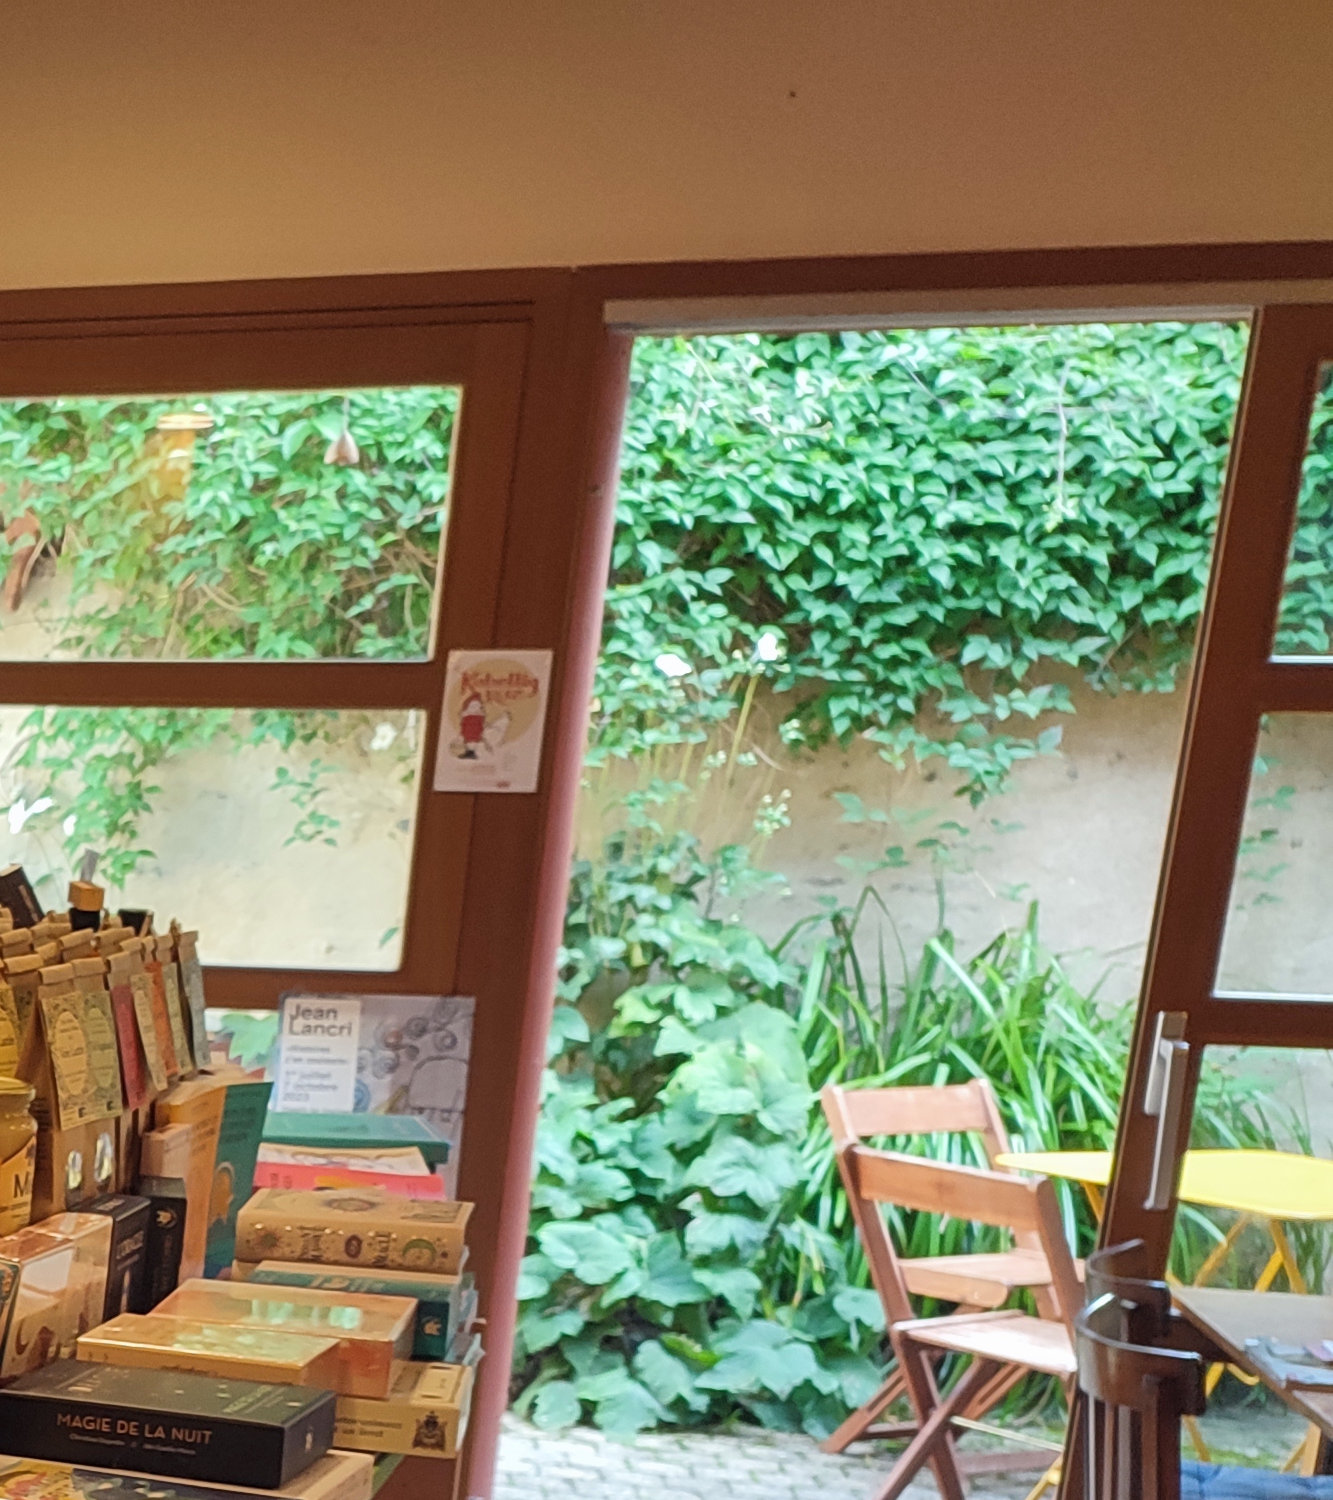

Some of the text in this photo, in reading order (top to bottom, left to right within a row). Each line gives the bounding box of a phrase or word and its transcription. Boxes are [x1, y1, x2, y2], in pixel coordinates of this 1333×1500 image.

[289, 1004, 338, 1020] Jean
[289, 1022, 353, 1037] Lancri
[57, 1412, 112, 1435] MAGIE
[116, 1420, 139, 1436] DE
[144, 1424, 167, 1439] LA
[171, 1428, 213, 1447] NUIT
